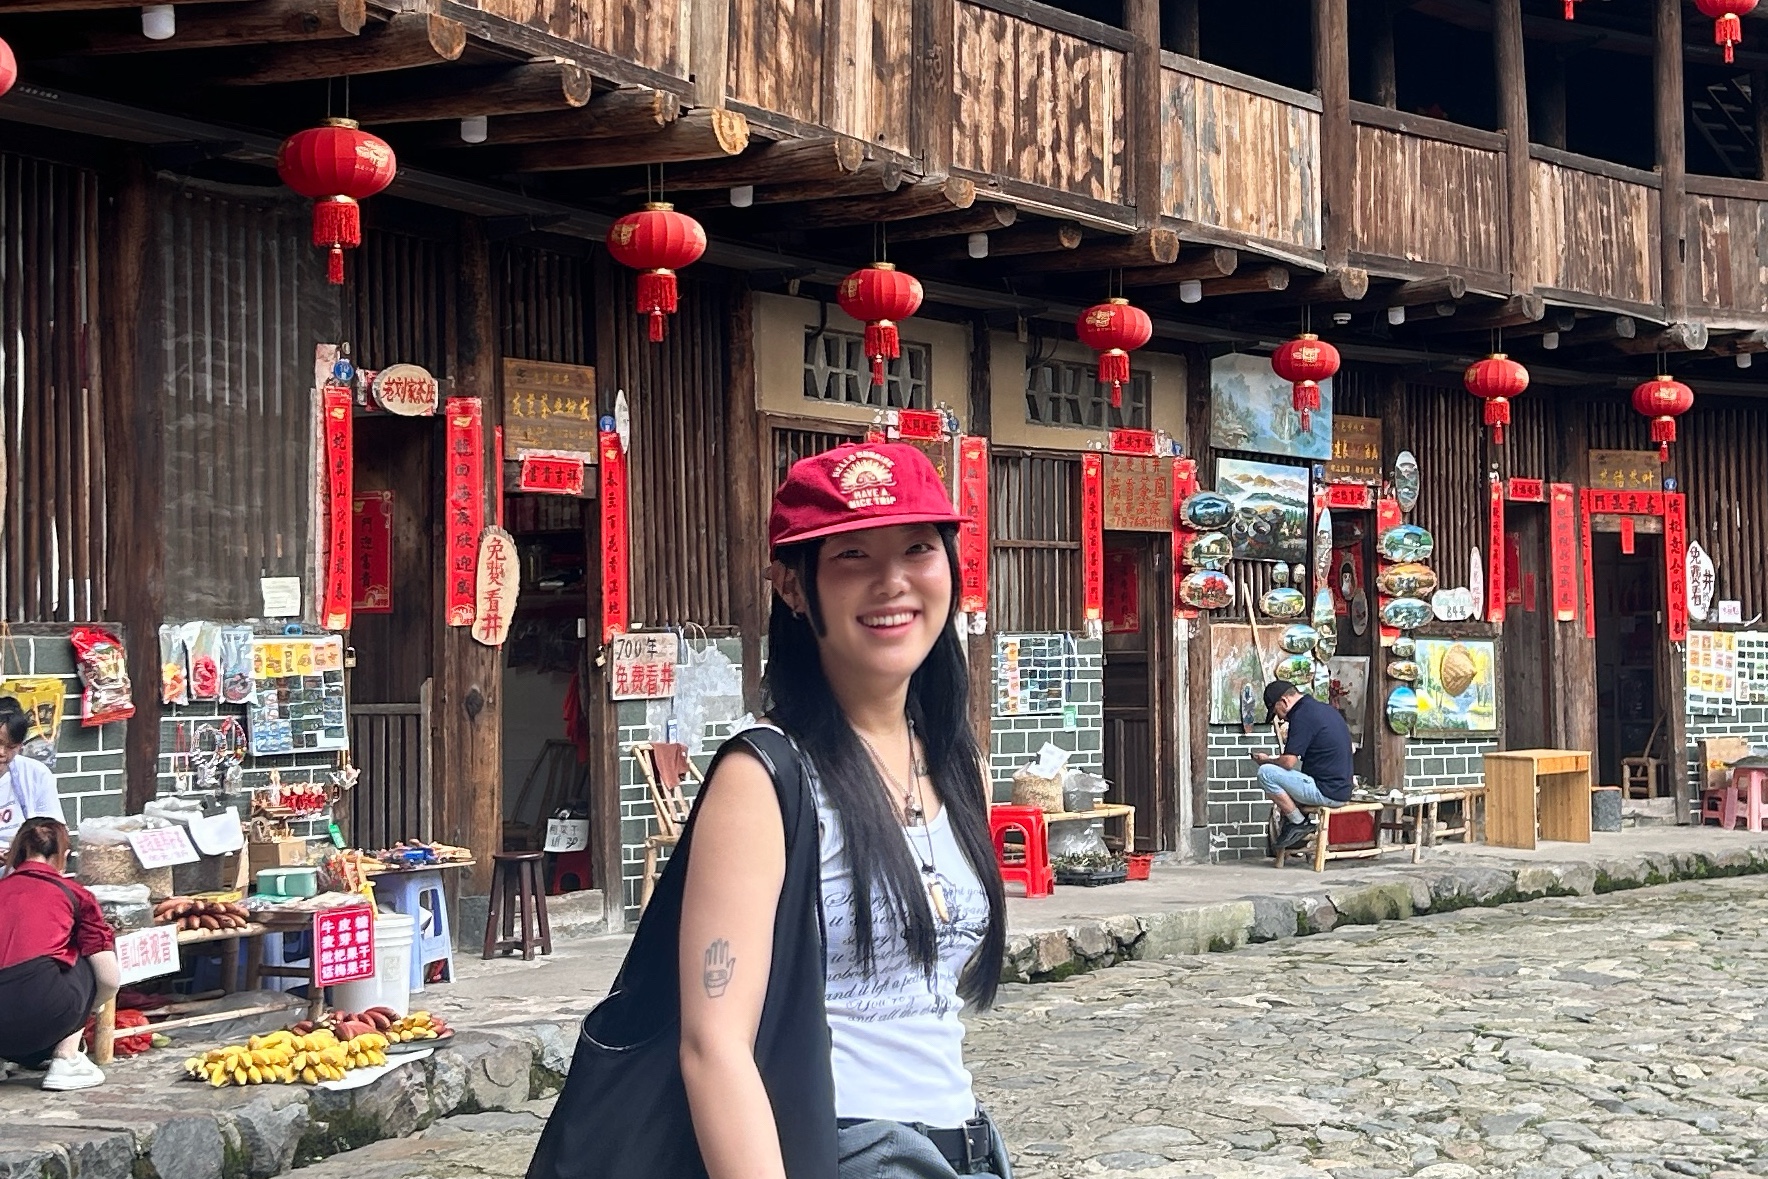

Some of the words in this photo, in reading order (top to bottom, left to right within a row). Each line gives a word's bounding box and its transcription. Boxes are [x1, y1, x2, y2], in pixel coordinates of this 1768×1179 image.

[832, 454, 857, 477] HELLO
[848, 497, 873, 509] NICE
[874, 496, 897, 505] TRIP
[853, 488, 879, 500] HAVE
[881, 488, 889, 497] A
[616, 637, 659, 661] 700年
[321, 915, 369, 934] 牛皮糖
[321, 930, 369, 950] 麦芽糖
